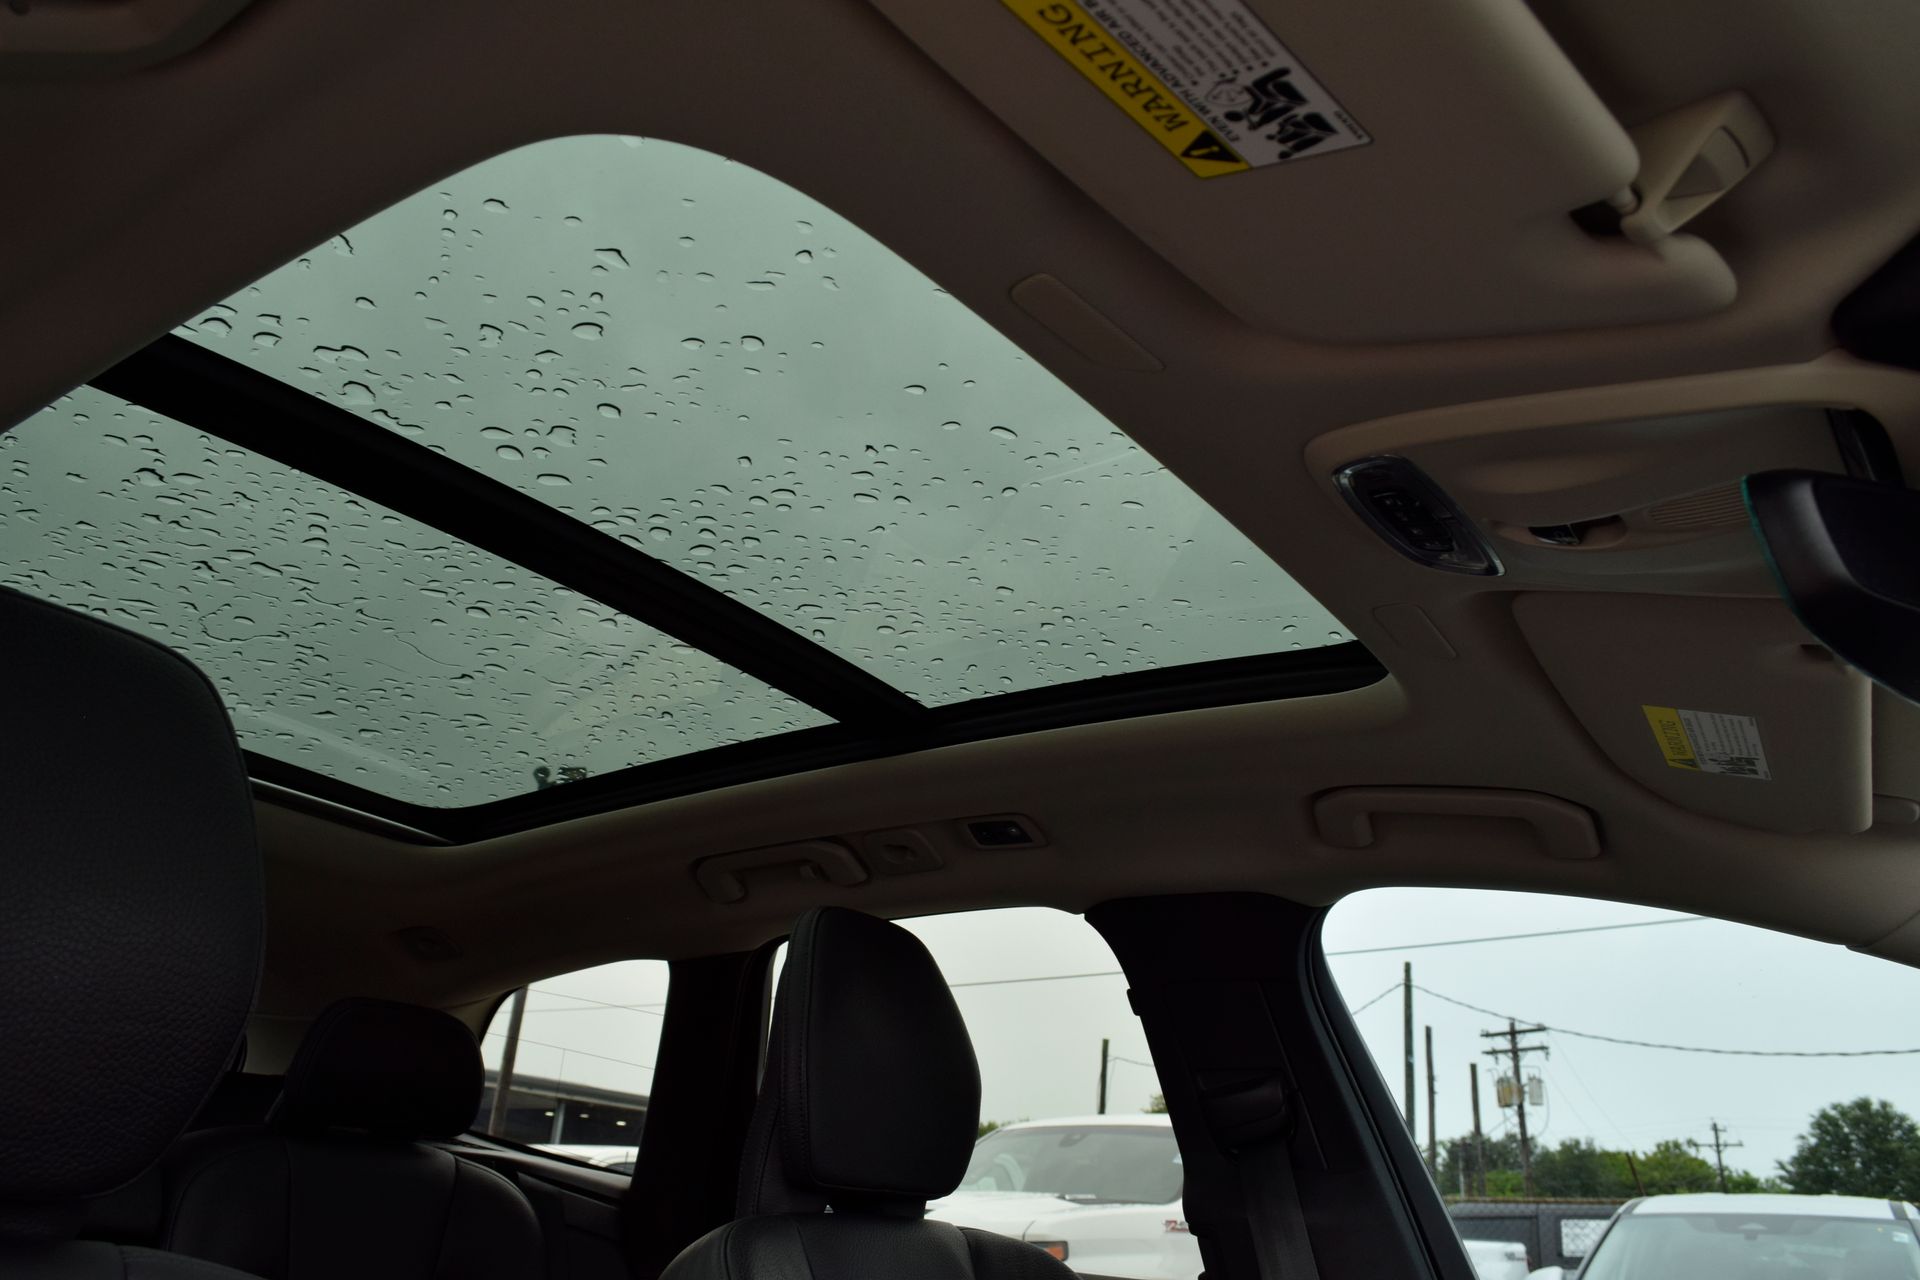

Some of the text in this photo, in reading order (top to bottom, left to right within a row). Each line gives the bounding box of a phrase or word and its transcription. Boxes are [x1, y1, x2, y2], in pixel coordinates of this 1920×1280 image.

[1093, 9, 1122, 29] AIR
[1037, 4, 1190, 132] WARNING
[1117, 31, 1185, 88] ADVANCED
[1178, 89, 1211, 114] WITH
[1206, 115, 1241, 141] EVEN
[1659, 720, 1688, 756] WARNING
